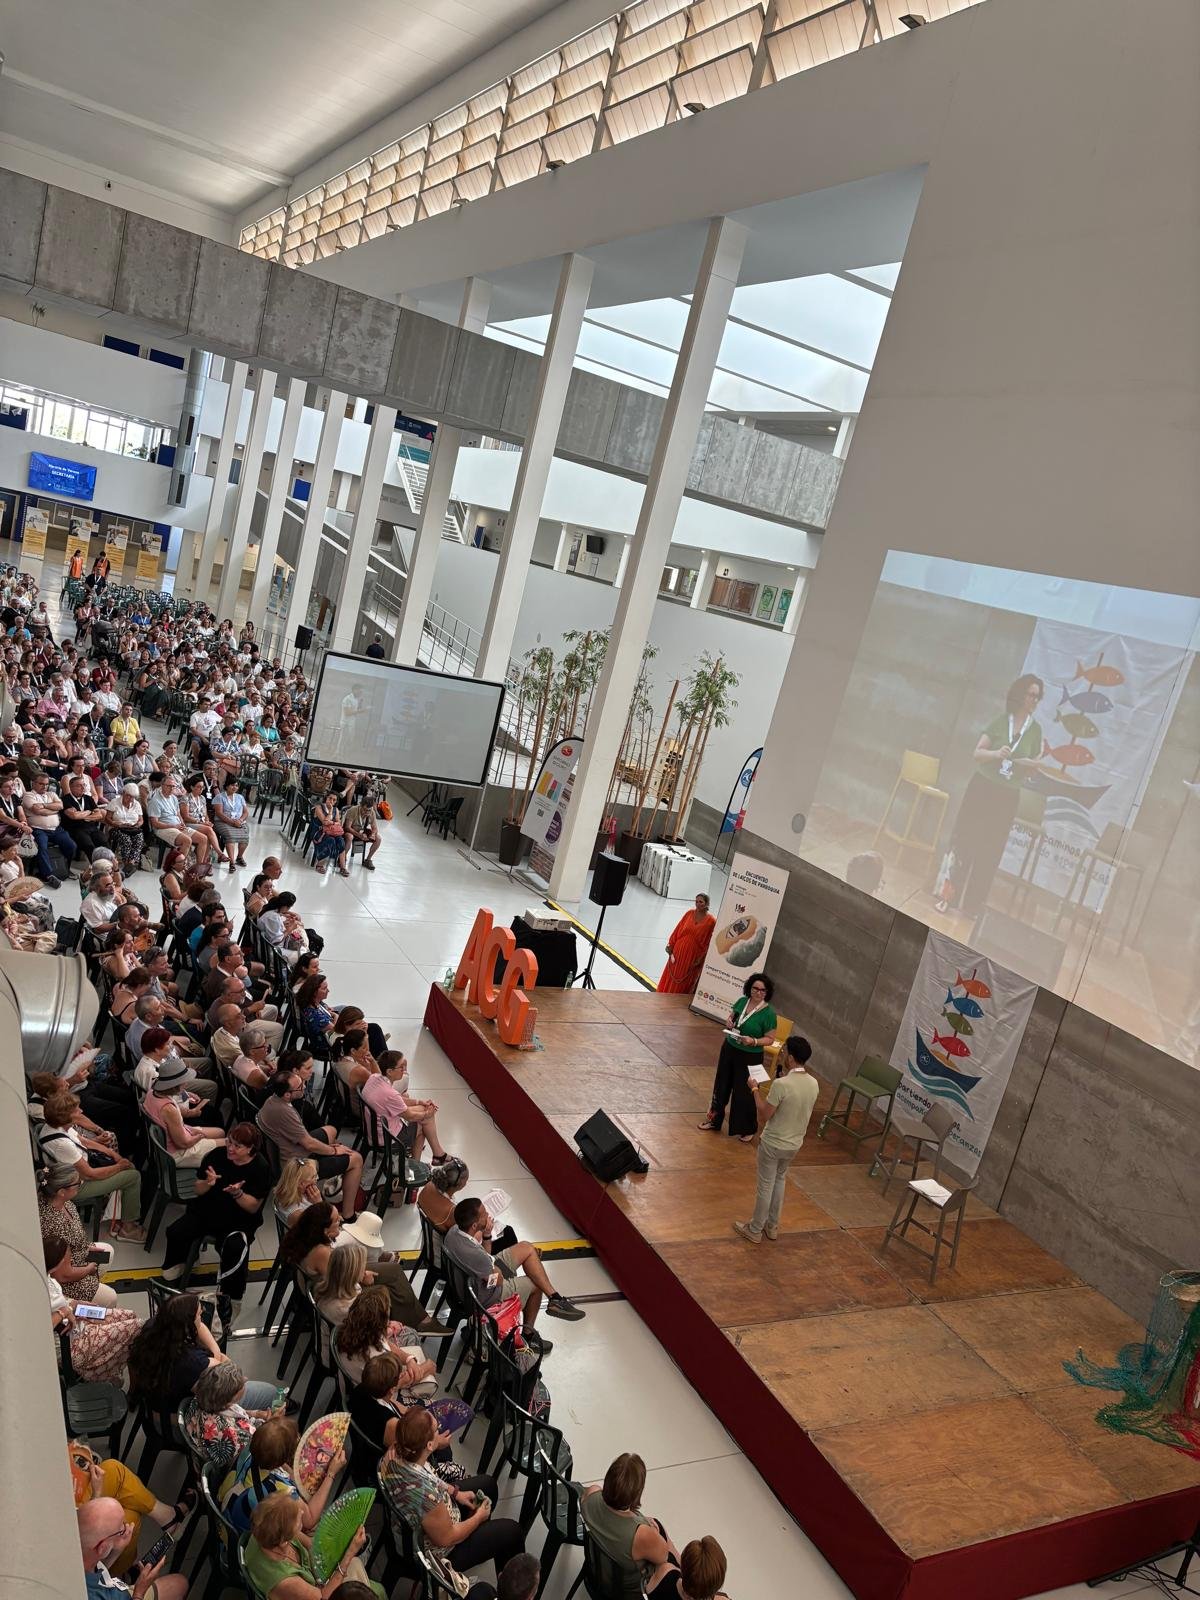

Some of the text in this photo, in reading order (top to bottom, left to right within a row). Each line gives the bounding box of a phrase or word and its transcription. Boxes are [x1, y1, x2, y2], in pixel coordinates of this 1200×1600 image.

[745, 870, 769, 884] ENCUENTRO
[758, 881, 780, 895] PARROQUIA
[454, 907, 539, 1046] ACG
